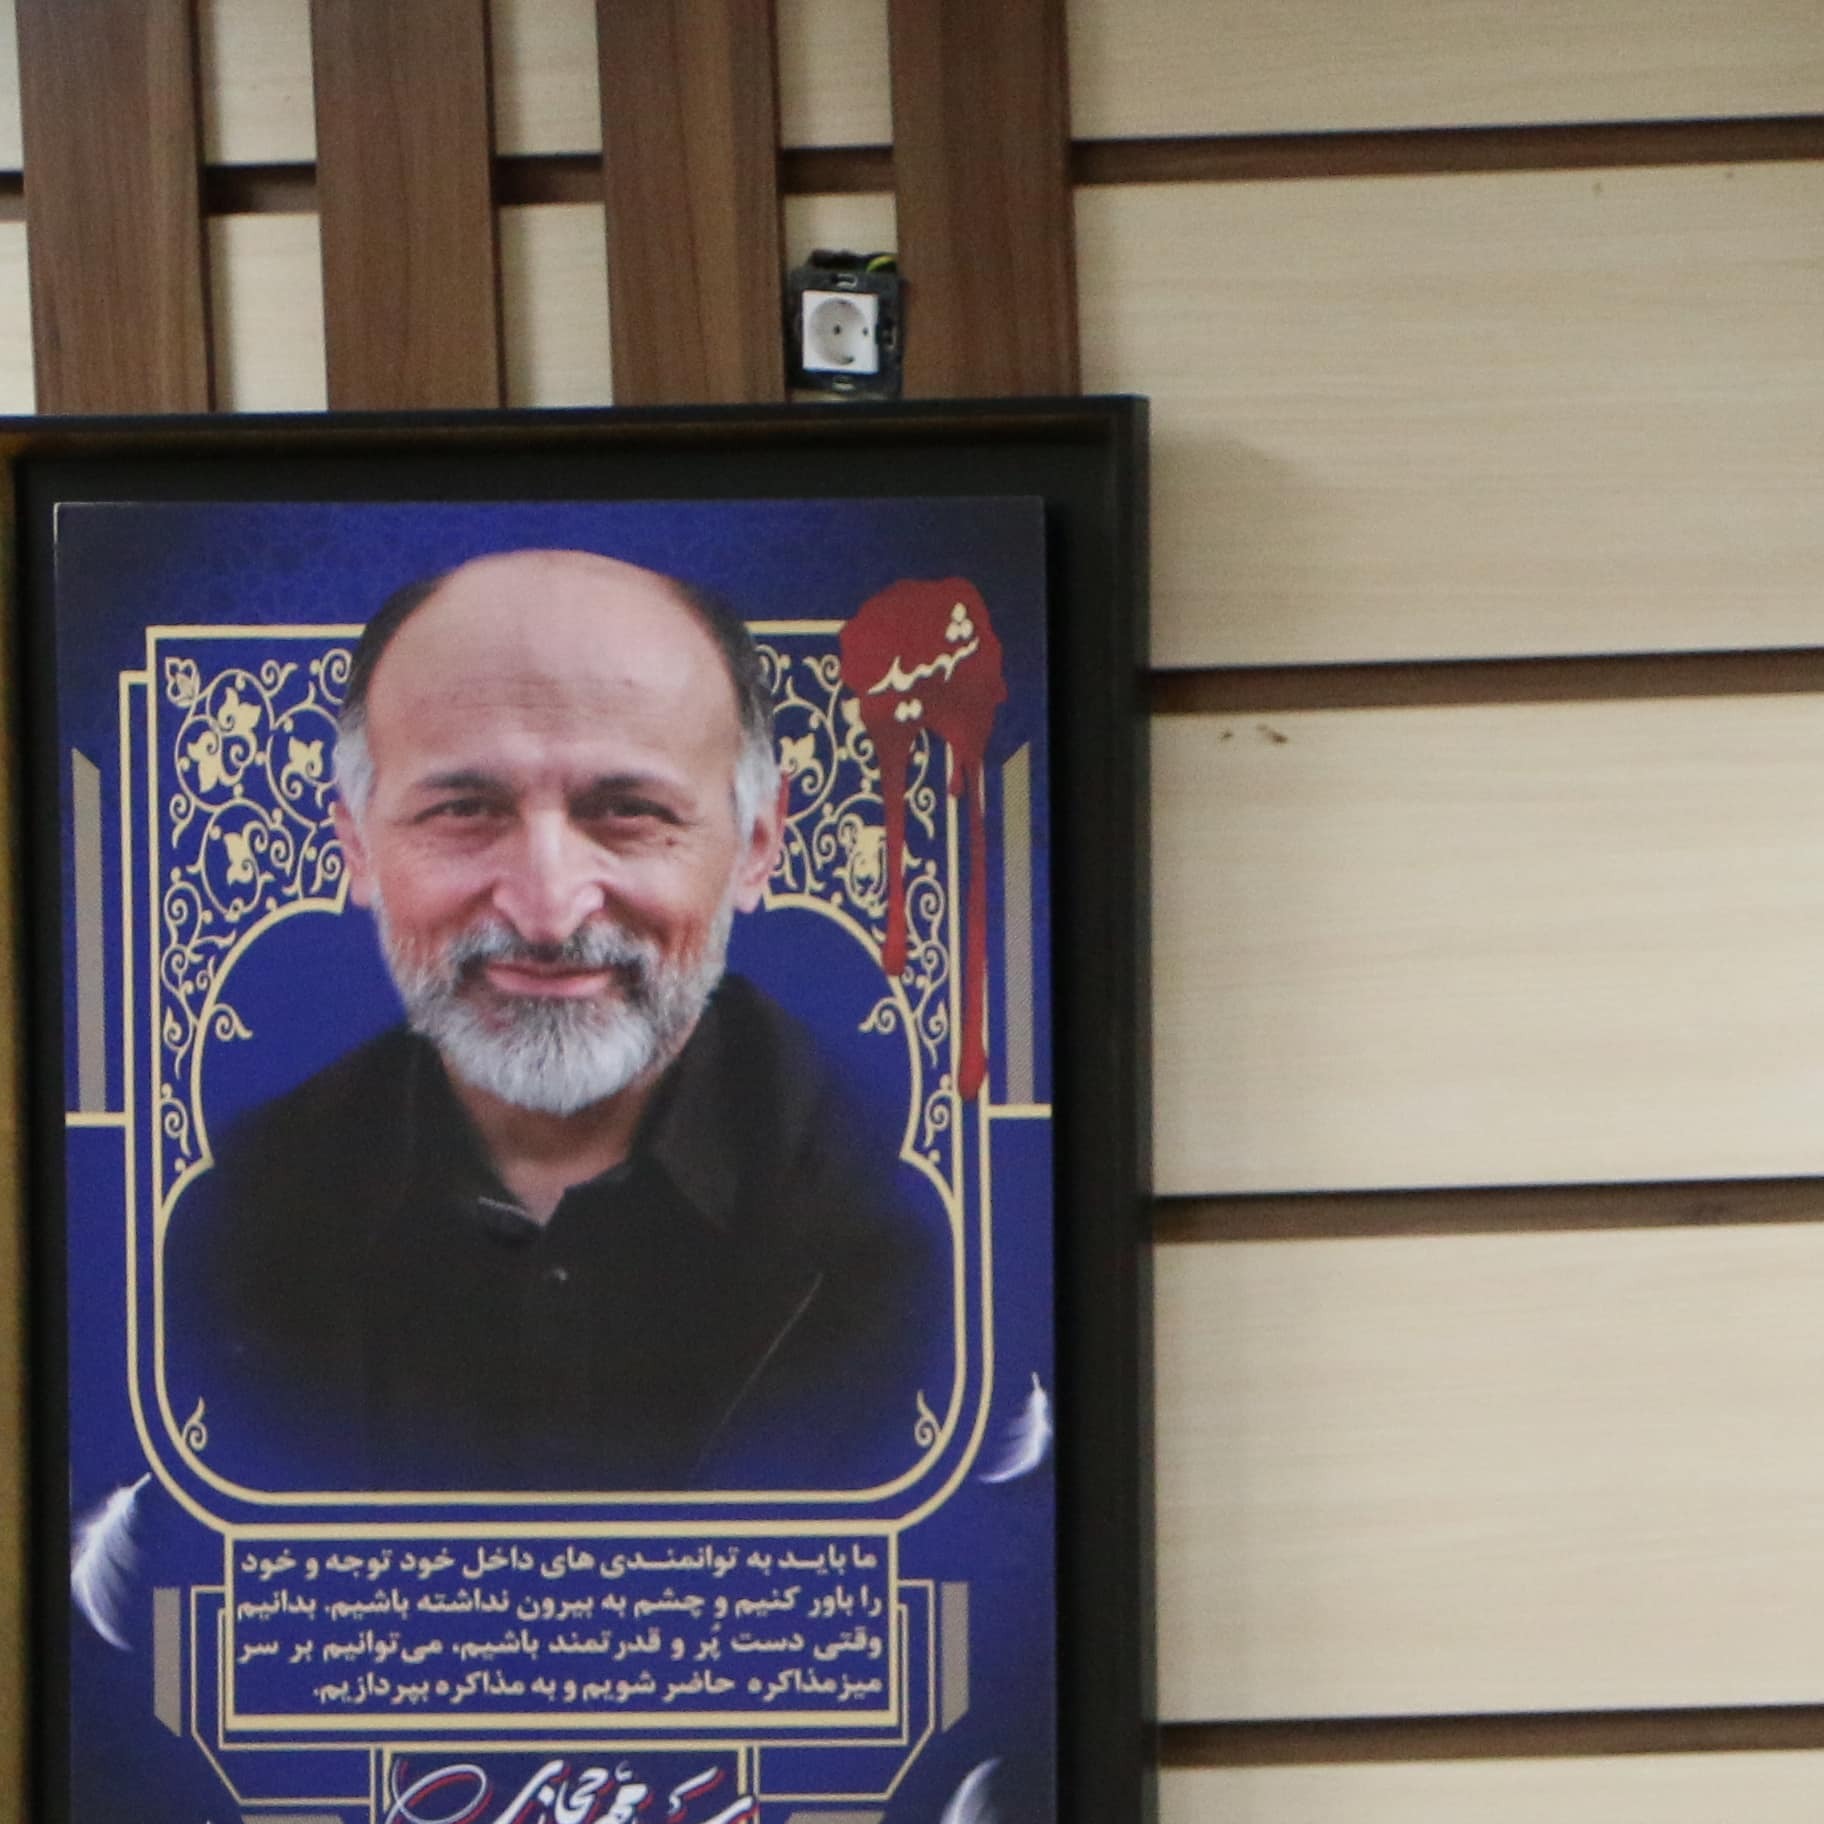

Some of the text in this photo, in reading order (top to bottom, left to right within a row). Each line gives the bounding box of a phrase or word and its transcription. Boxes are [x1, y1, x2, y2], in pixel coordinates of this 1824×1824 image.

[865, 601, 981, 724] شهید
[240, 1543, 878, 1582] ما باید به توانمندی های داخل خود توجه و خود
[237, 1587, 318, 1622] بدانیم
[416, 1587, 511, 1614] نداشته
[515, 1594, 595, 1621] بیرون
[600, 1592, 628, 1619] به
[633, 1586, 706, 1620] چشم
[713, 1595, 729, 1619] و
[734, 1585, 802, 1618] کنیم
[806, 1584, 856, 1618] باور
[860, 1584, 884, 1618] را
[236, 1639, 281, 1665] سر
[287, 1640, 315, 1664] بر
[548, 1625, 662, 1662] قدرتمند
[670, 1636, 687, 1661] و
[730, 1630, 806, 1652] دست
[812, 1624, 884, 1662] وقتی
[433, 1669, 526, 1705] مذاکره
[529, 1676, 558, 1703] به
[562, 1679, 579, 1704] و
[581, 1669, 657, 1703] شویم
[662, 1669, 736, 1704] حاضر
